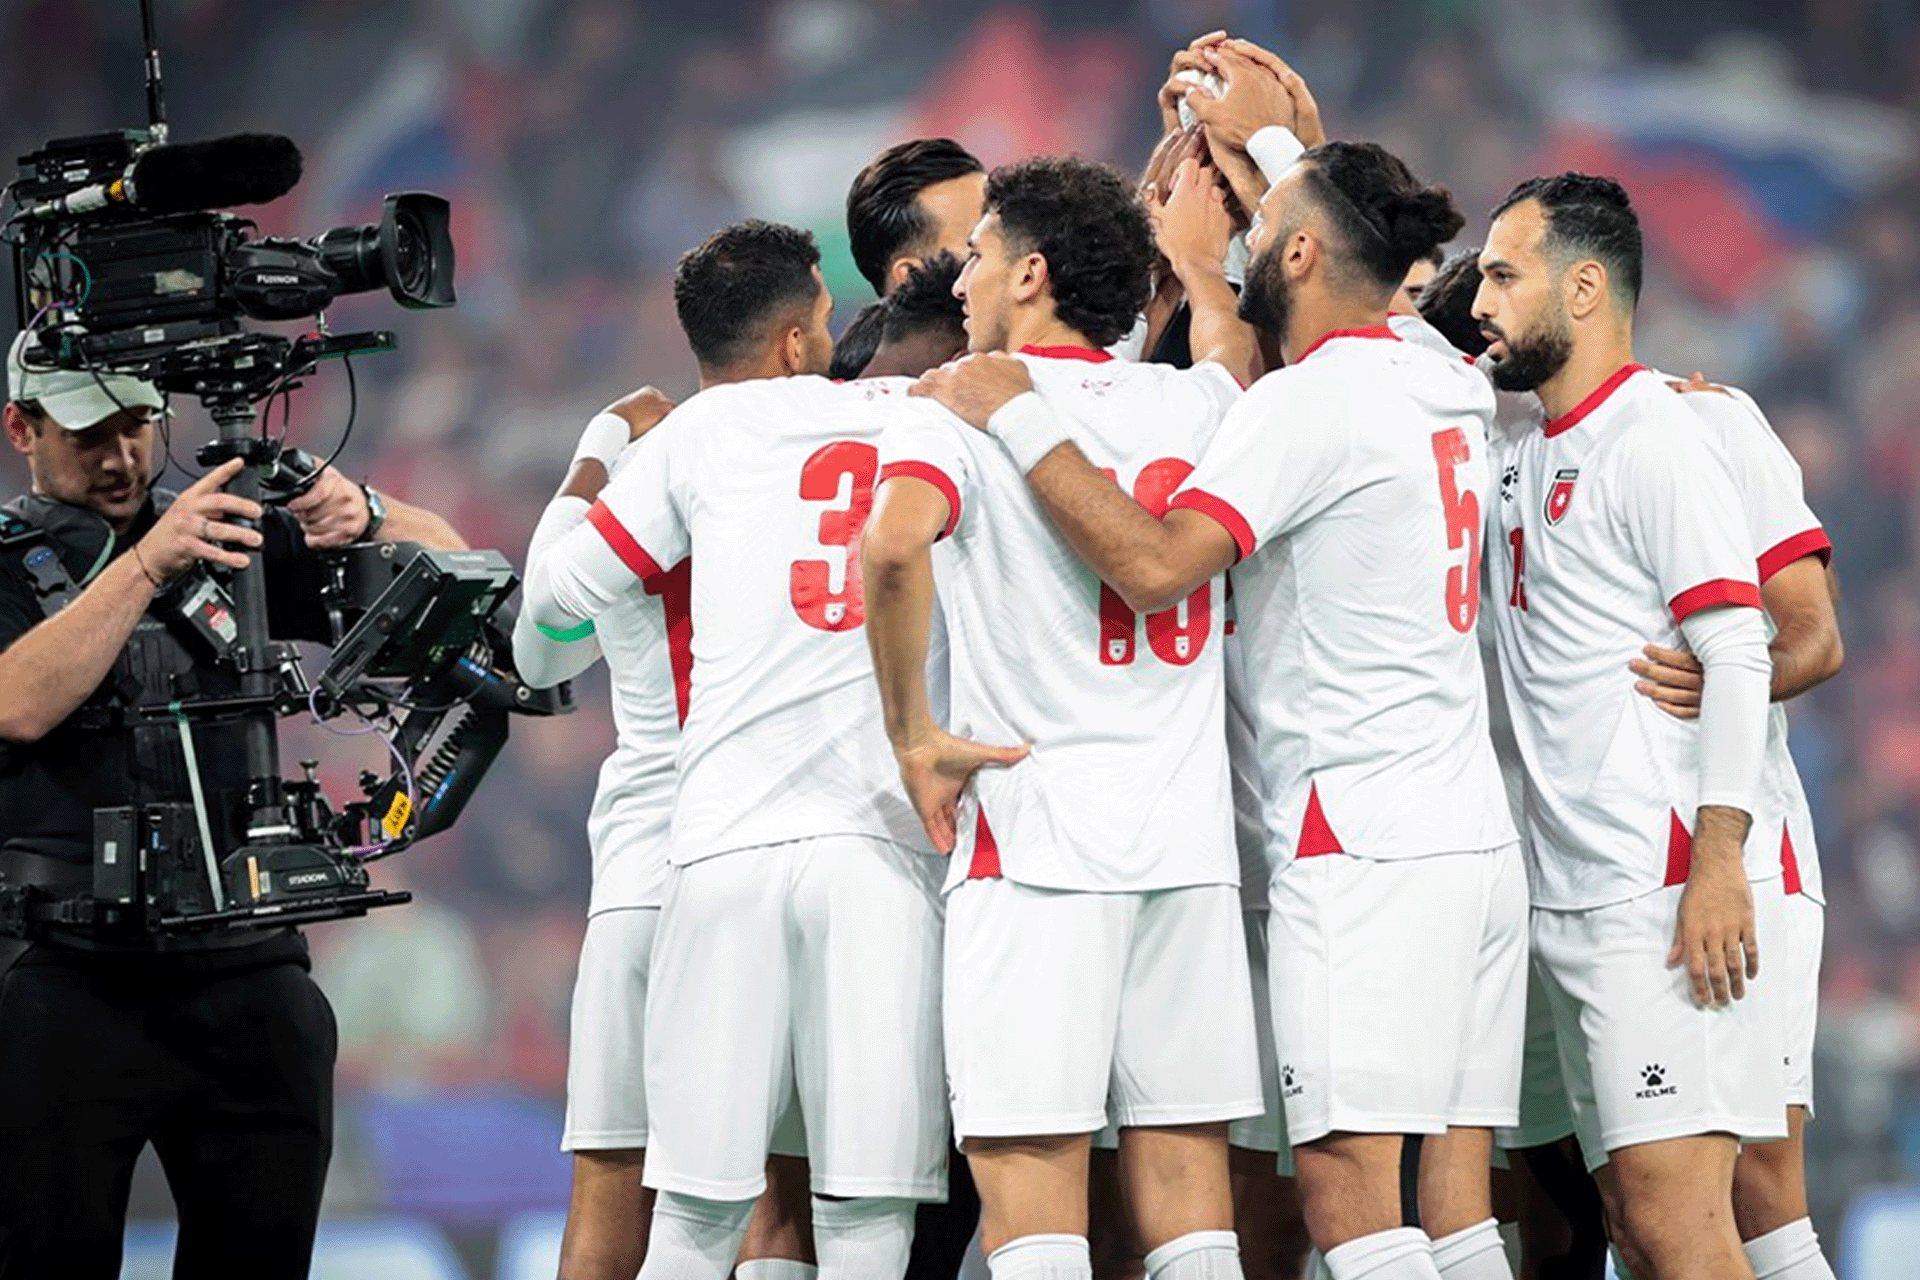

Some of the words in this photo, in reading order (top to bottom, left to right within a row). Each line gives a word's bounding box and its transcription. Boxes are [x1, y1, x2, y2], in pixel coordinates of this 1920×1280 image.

[257, 274, 299, 284] FUJINON
[790, 440, 878, 632] 3
[1432, 427, 1480, 634] 5
[1635, 1085, 1677, 1099] KELME
